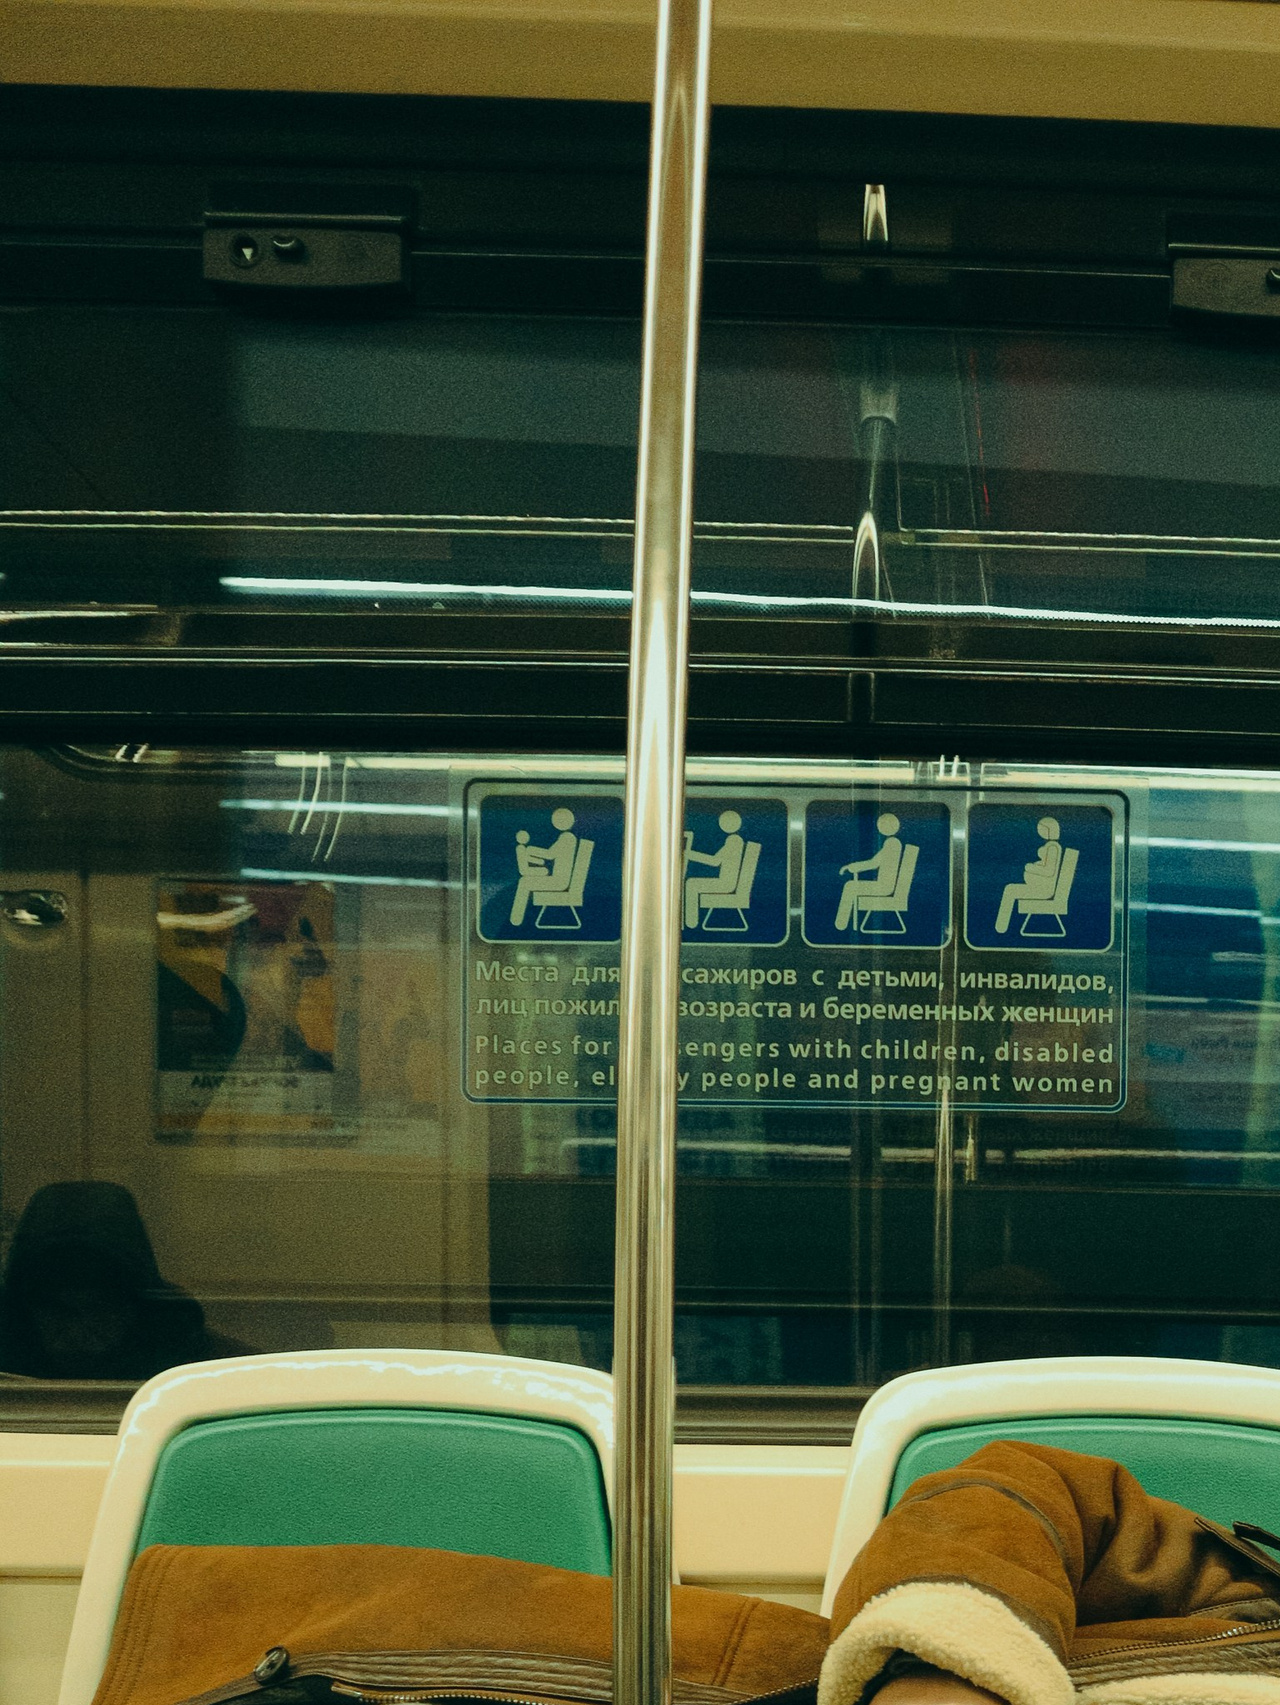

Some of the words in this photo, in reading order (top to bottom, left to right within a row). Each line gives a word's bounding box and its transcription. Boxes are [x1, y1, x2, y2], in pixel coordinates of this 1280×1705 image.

[475, 961, 558, 983] Места
[572, 967, 620, 985] для
[681, 968, 797, 990] сажиров
[812, 970, 824, 985] с
[838, 969, 944, 991] детьми,
[960, 971, 1114, 994] инвалидов,
[477, 999, 528, 1018] лиц
[535, 1000, 620, 1016] пожил
[801, 1003, 815, 1018] и
[823, 996, 994, 1024] беременных
[1001, 1006, 1114, 1026] женщин
[476, 1035, 562, 1056] Places
[572, 1035, 611, 1056] for
[678, 1041, 779, 1062] engers
[788, 1038, 851, 1059] with
[861, 1039, 985, 1064] children,
[995, 1042, 1114, 1064] disabled
[476, 1066, 579, 1089] people,
[702, 1068, 796, 1092] people
[808, 1069, 858, 1089] and
[871, 1072, 1001, 1095] pregnant
[1012, 1077, 1113, 1093] women
